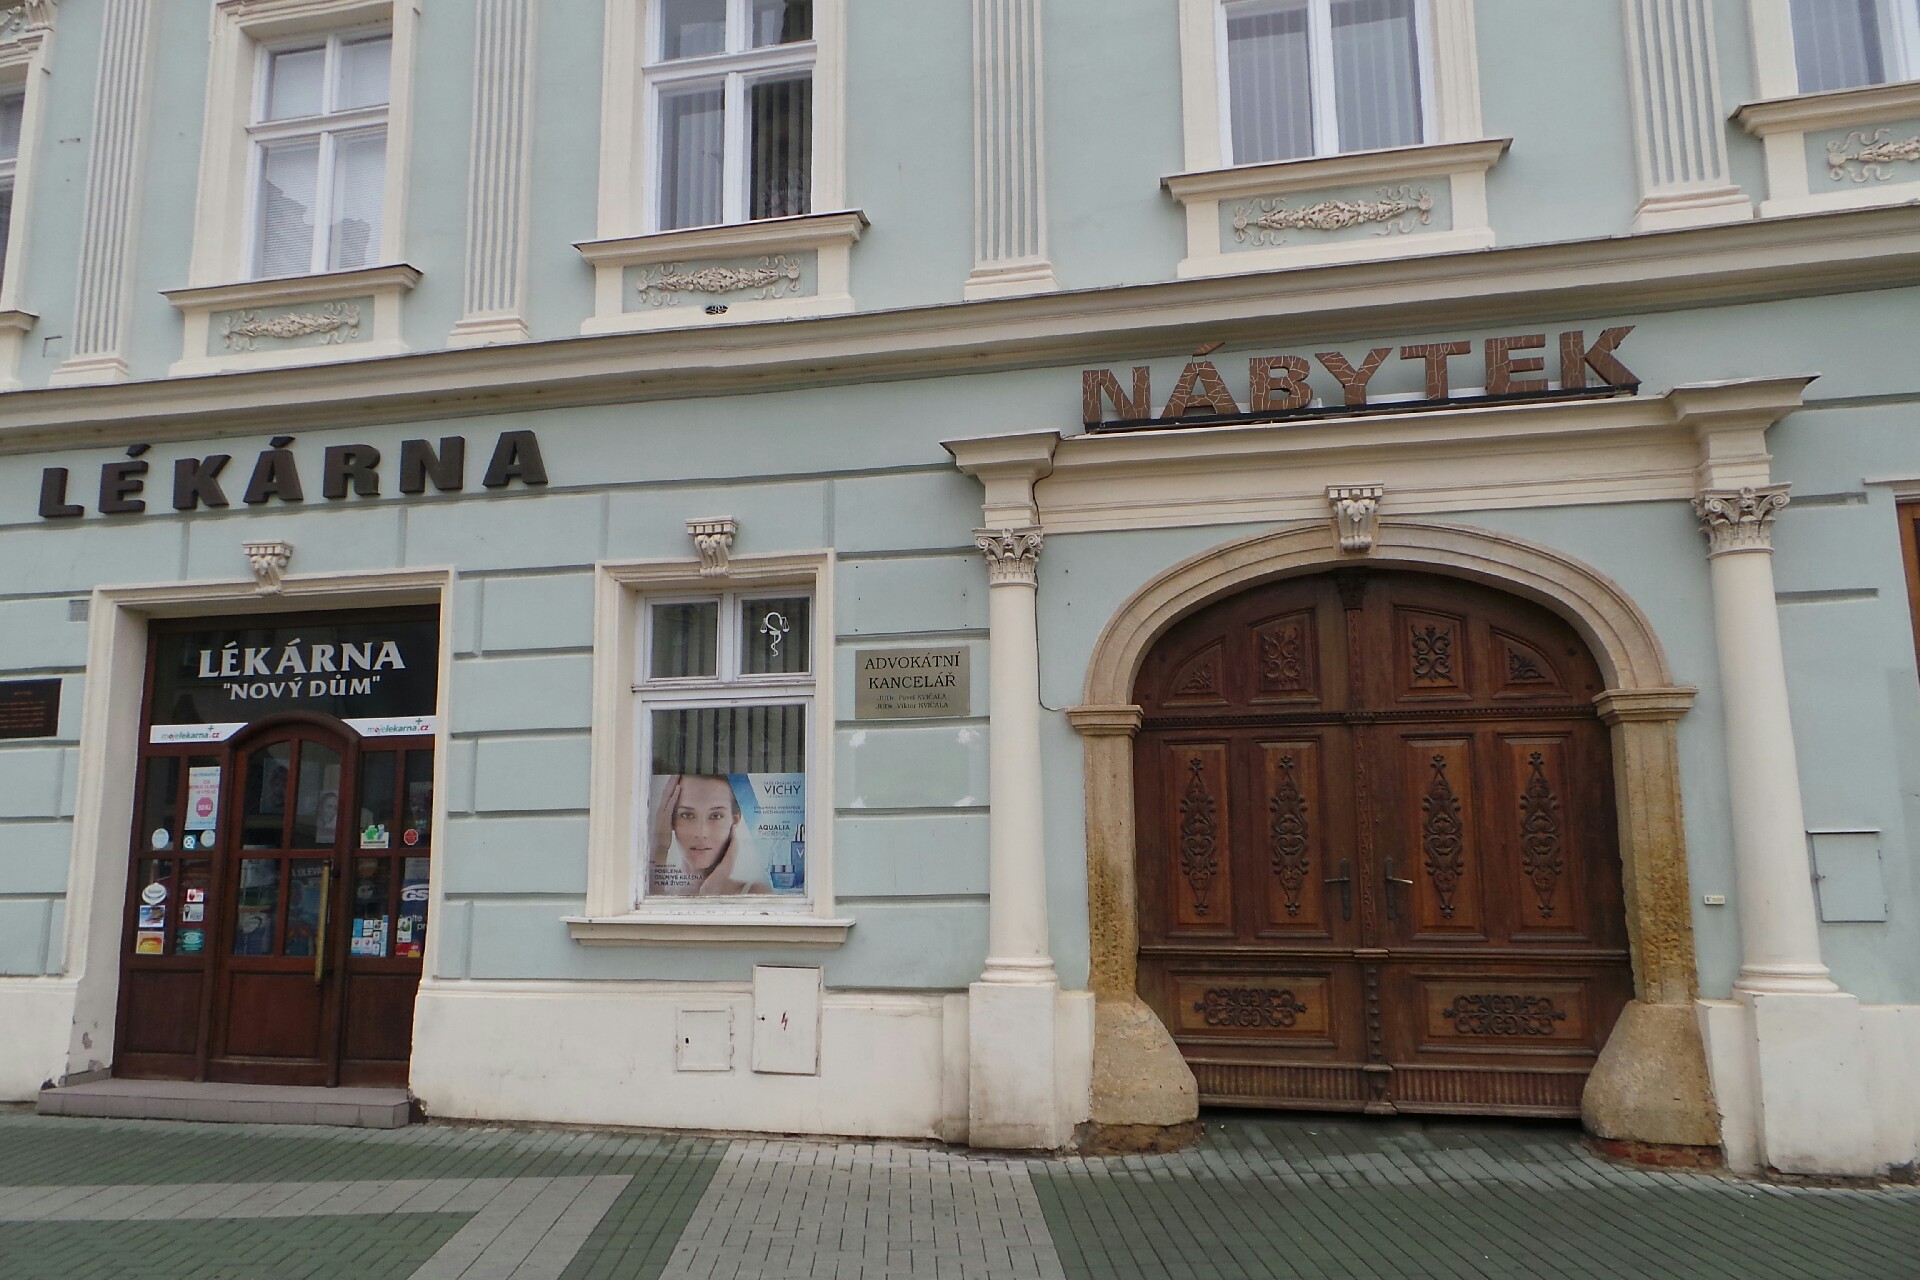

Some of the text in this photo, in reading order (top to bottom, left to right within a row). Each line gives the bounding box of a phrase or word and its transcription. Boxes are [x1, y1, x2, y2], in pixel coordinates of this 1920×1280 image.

[1082, 325, 1641, 426] NÁBYTEK
[38, 430, 549, 518] LÉKÁRNA
[197, 637, 406, 679] LÉKÁRNA
[864, 650, 961, 670] ADVOKÁTNÍ
[223, 673, 381, 701] "NOVÝ DŮM"
[868, 671, 956, 689] KANCELÁŘ
[763, 785, 801, 795] VICHY
